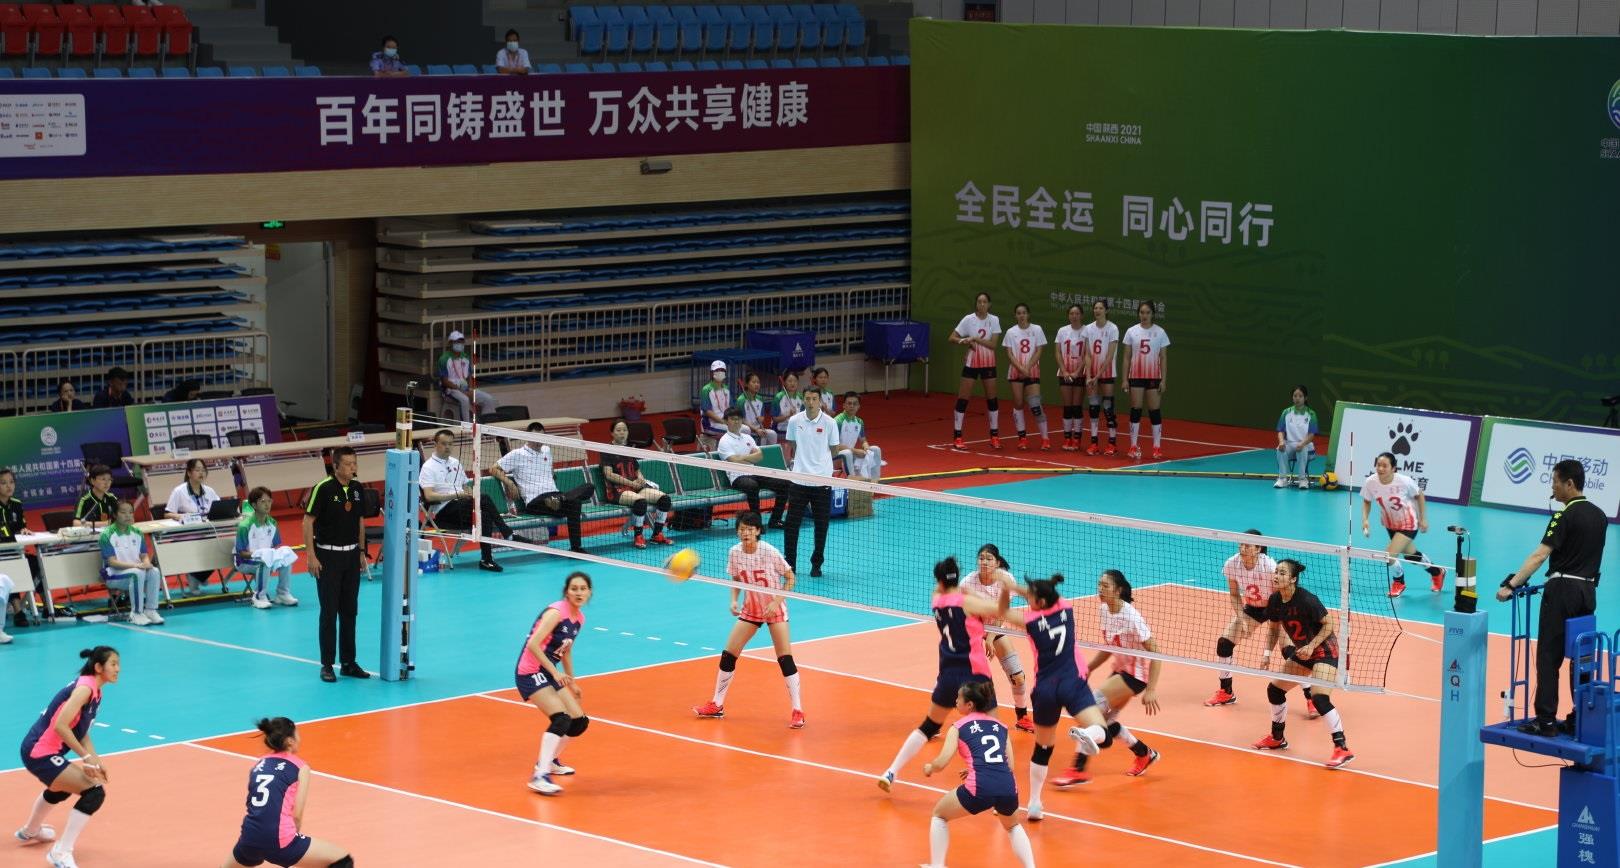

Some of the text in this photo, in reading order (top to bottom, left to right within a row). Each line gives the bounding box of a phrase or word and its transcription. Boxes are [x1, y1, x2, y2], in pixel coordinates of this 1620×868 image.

[316, 81, 809, 146] 百年同铸盛世 万众共享健康
[1086, 135, 1141, 144] SHAANXI CHINA
[1121, 125, 1141, 136] 2021
[955, 180, 1274, 247] 全民全运 同心同行
[1050, 292, 1166, 313] 中华人民共和第十四届会
[1020, 339, 1031, 354] 8
[1064, 339, 1084, 357] 11
[1093, 340, 1102, 354] 6
[1140, 339, 1150, 355] 5
[1376, 496, 1403, 512] 13
[740, 569, 769, 588] 15
[1245, 584, 1262, 602] 3
[943, 624, 956, 652] 1
[1287, 620, 1307, 641] 2
[1048, 624, 1067, 656] 7
[531, 672, 549, 686] 10
[981, 734, 1004, 763] 2
[50, 755, 65, 767] 6
[251, 774, 275, 807] 3
